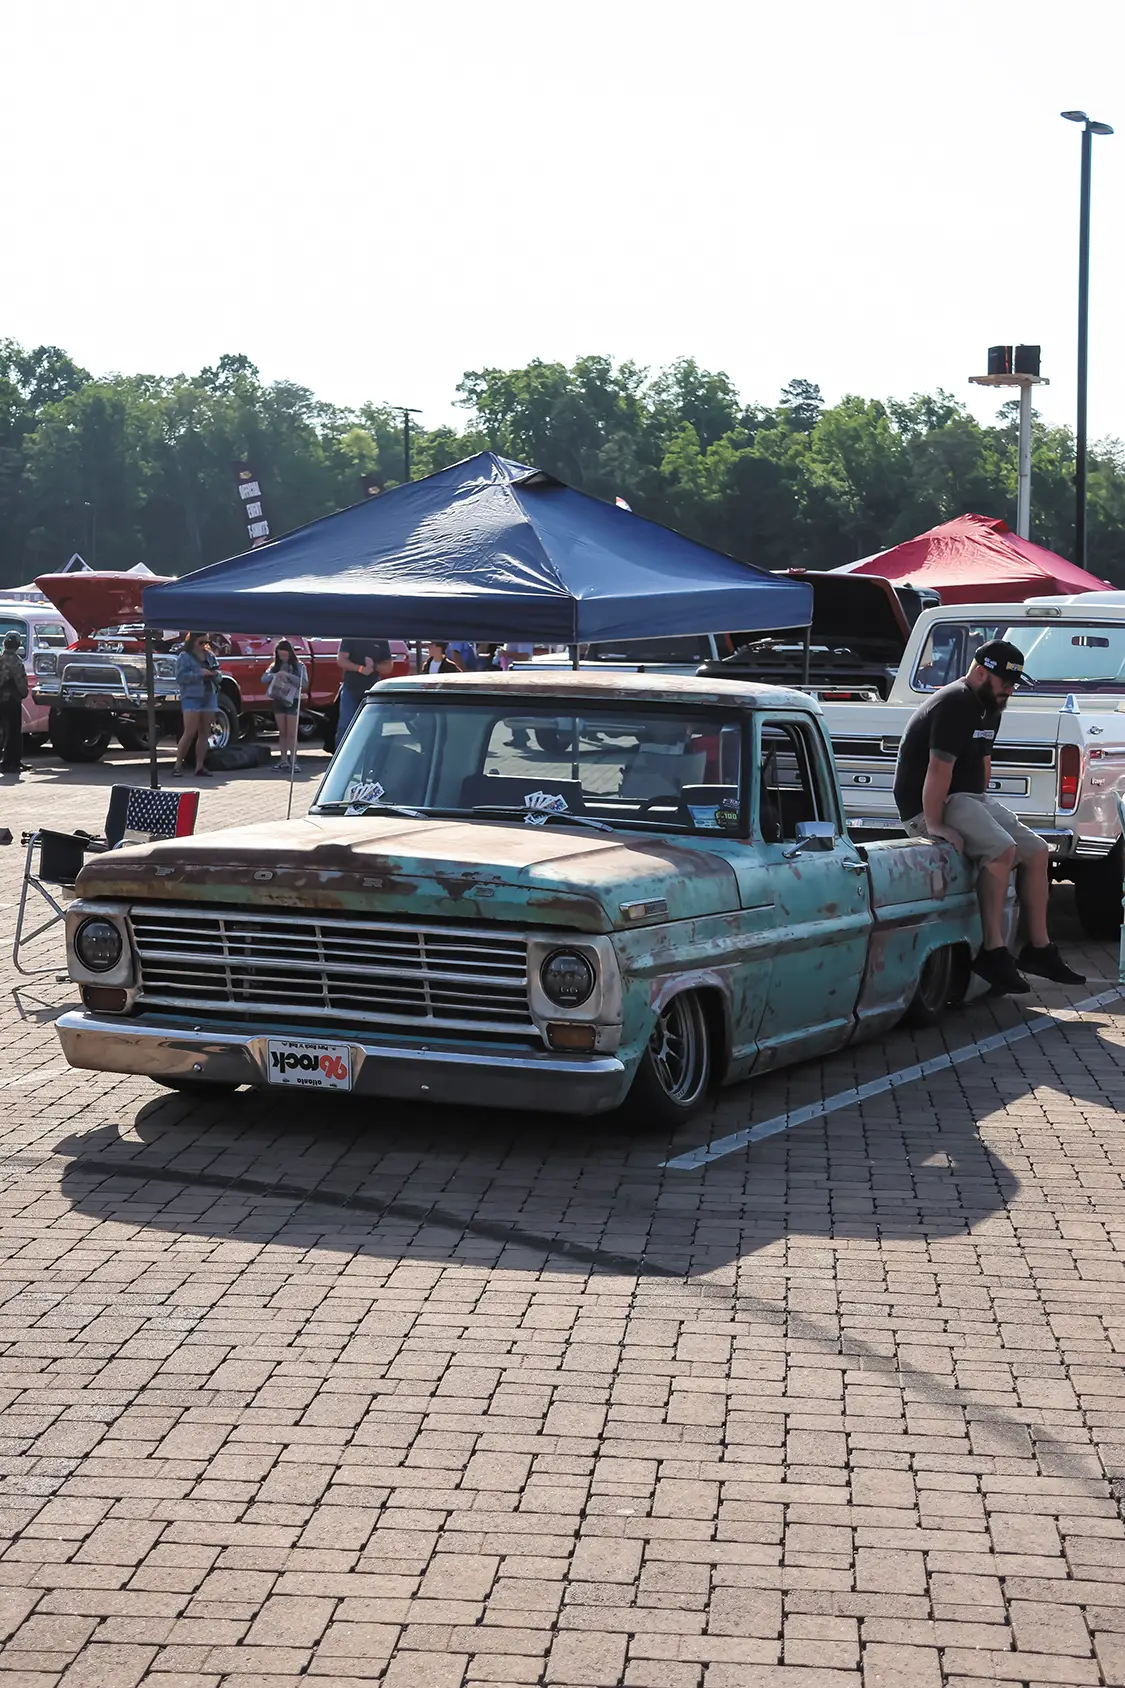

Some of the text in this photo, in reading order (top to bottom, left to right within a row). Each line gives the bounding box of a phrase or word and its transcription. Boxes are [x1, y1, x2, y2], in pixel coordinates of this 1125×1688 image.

[239, 482, 261, 499] OFFICIAL
[246, 502, 262, 518] EVENT
[248, 520, 269, 538] T-SHIRTS
[297, 1078, 322, 1086] atlanta
